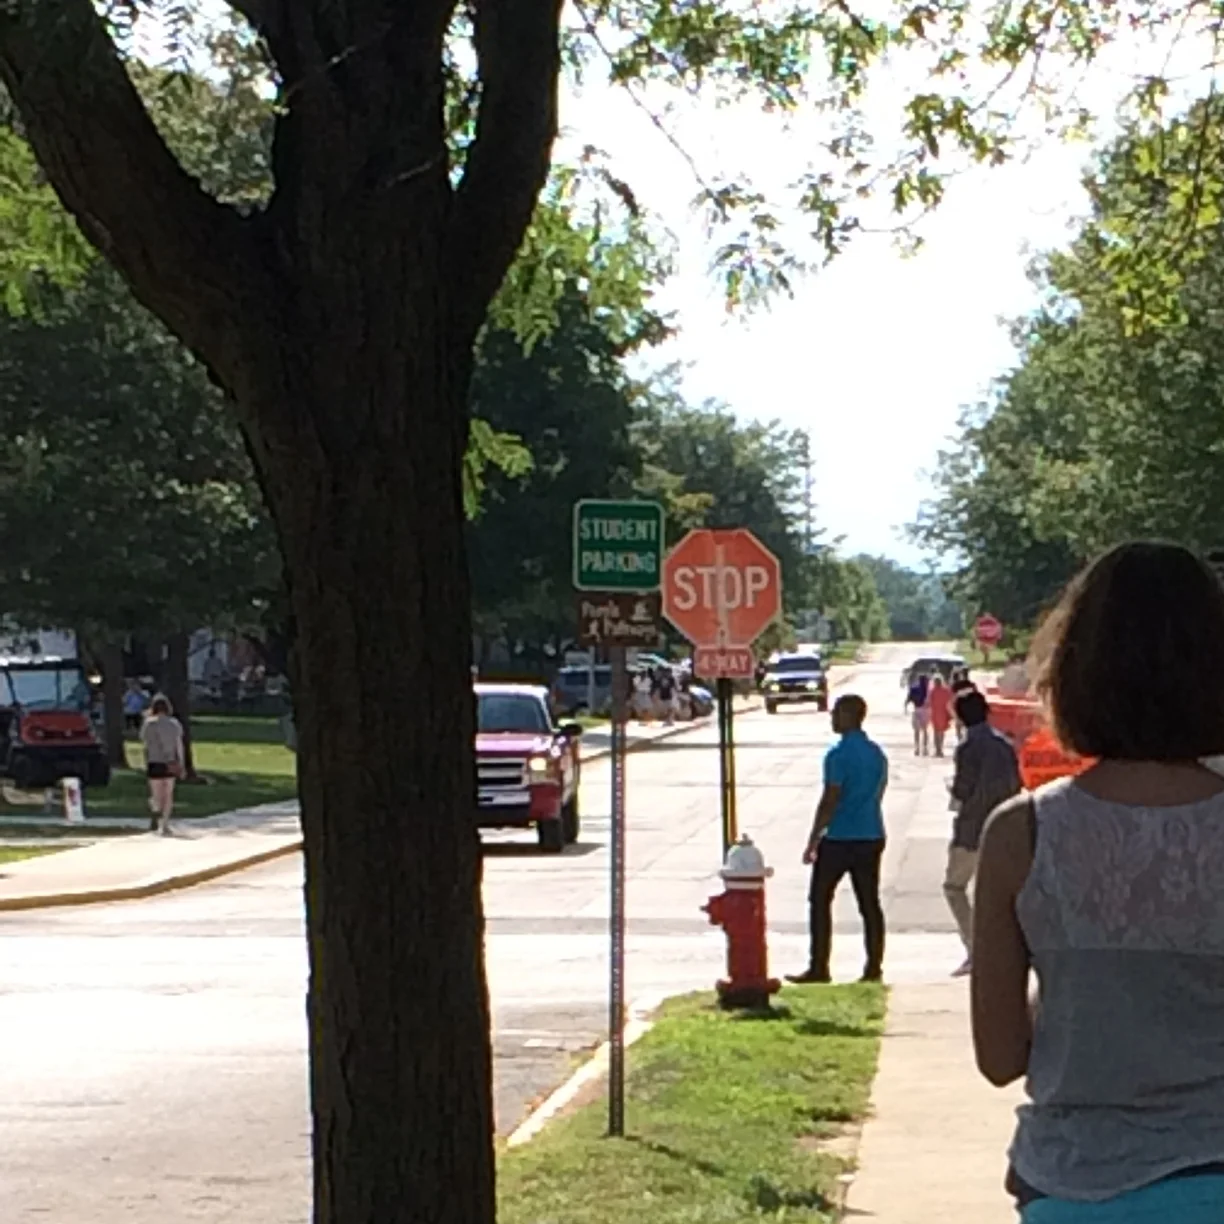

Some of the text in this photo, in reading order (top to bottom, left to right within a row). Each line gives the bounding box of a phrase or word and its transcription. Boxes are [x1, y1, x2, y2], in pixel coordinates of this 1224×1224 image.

[581, 519, 656, 541] STUDENT
[582, 552, 655, 573] PARKING
[674, 567, 768, 610] STOP
